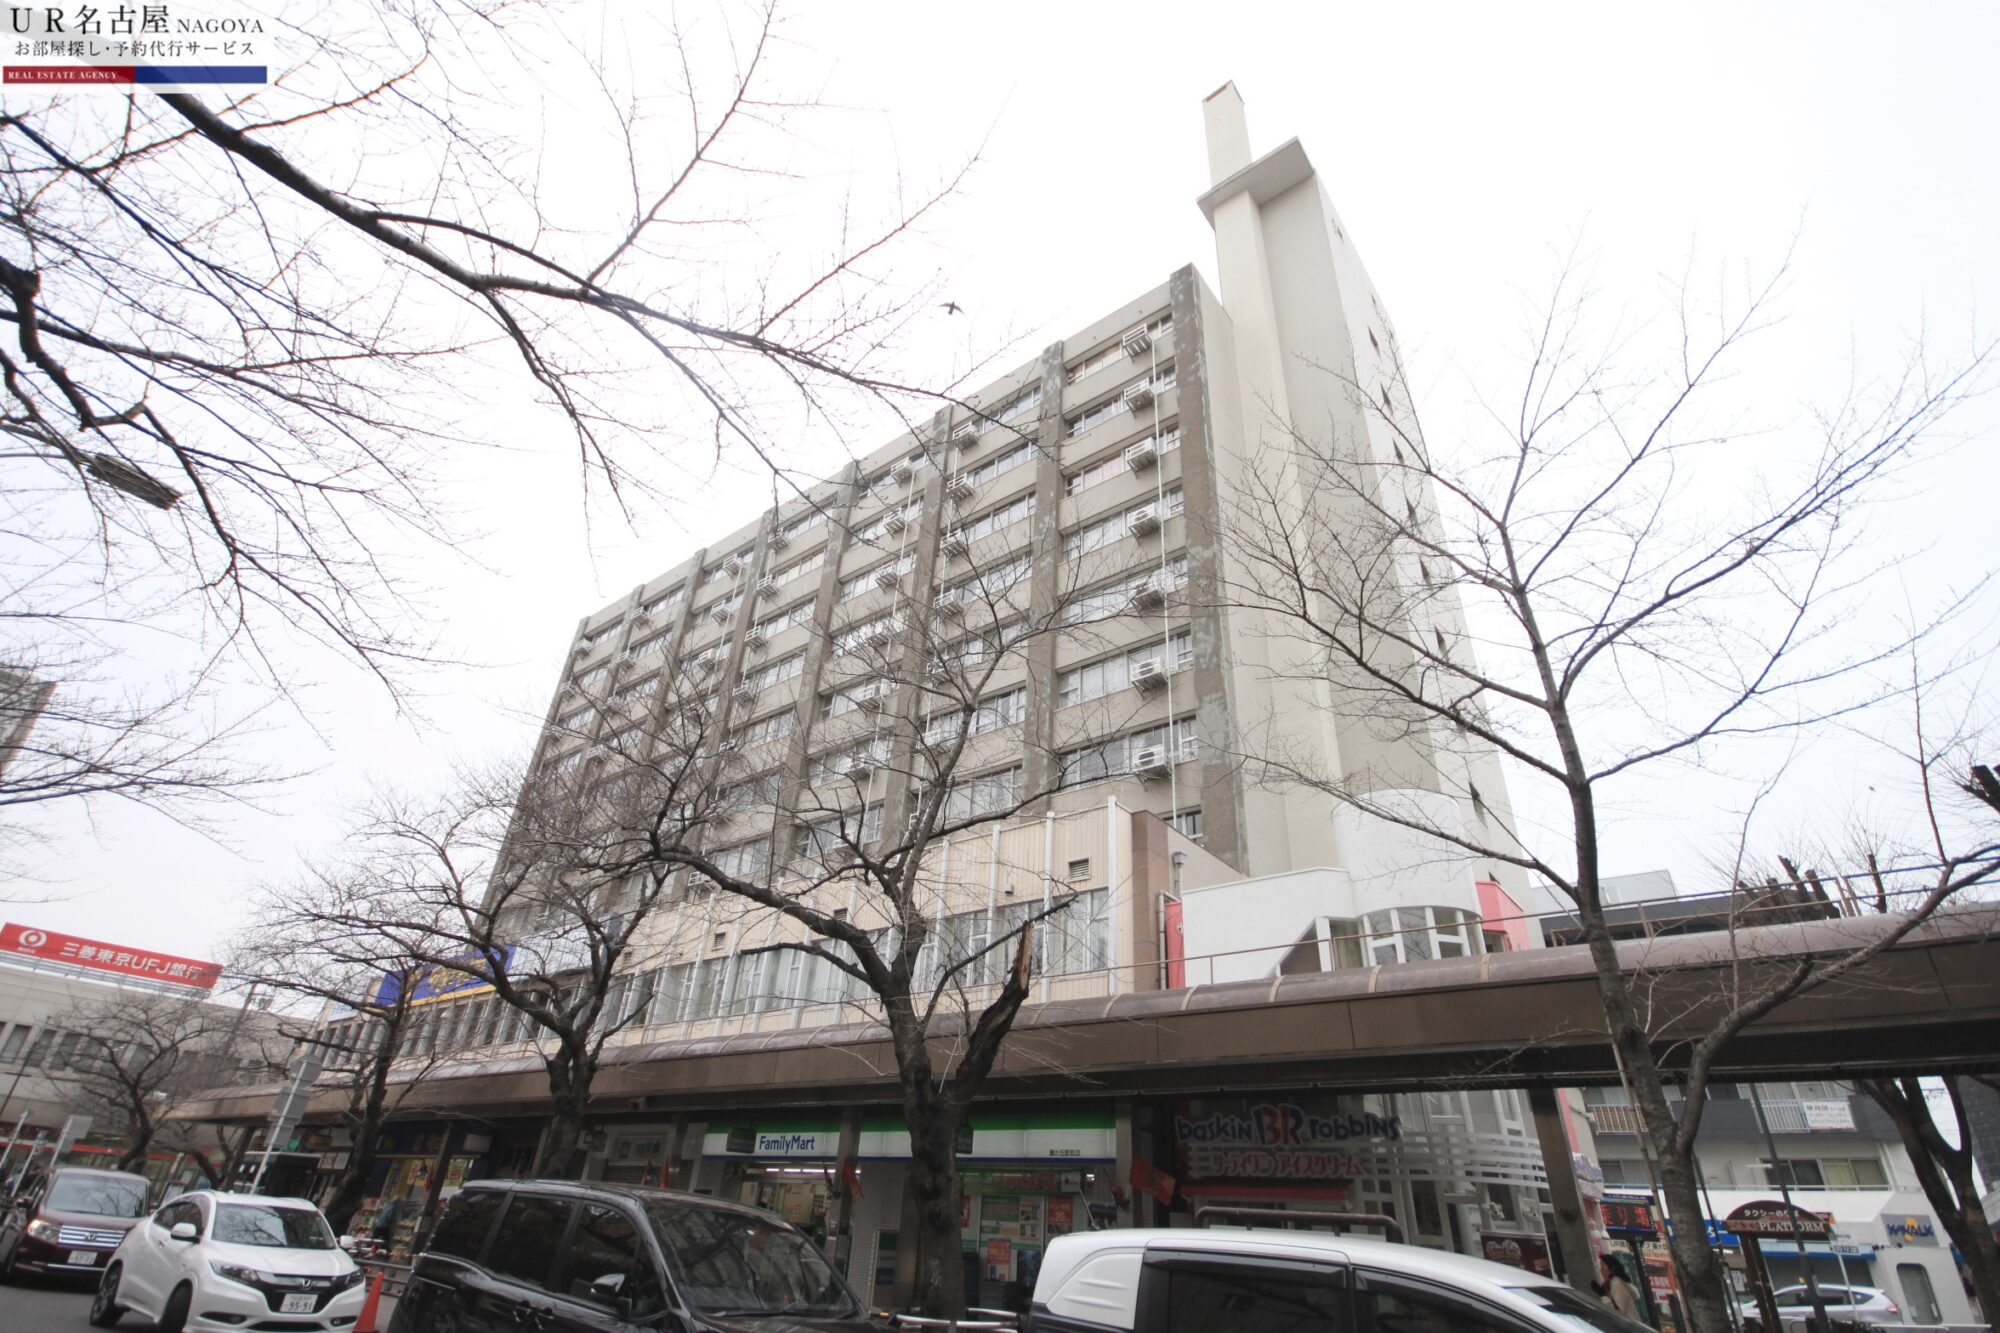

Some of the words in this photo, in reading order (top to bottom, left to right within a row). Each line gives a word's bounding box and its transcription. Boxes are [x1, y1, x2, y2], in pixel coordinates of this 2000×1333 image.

[60, 941, 203, 979] 三菱東京UFJ銀行
[1177, 1116, 1250, 1142] baskin
[1308, 1114, 1401, 1141] robbins
[759, 1135, 815, 1154] FamilyMart
[1213, 1153, 1273, 1176] サーティワン
[1277, 1152, 1364, 1176] アイスクリーム
